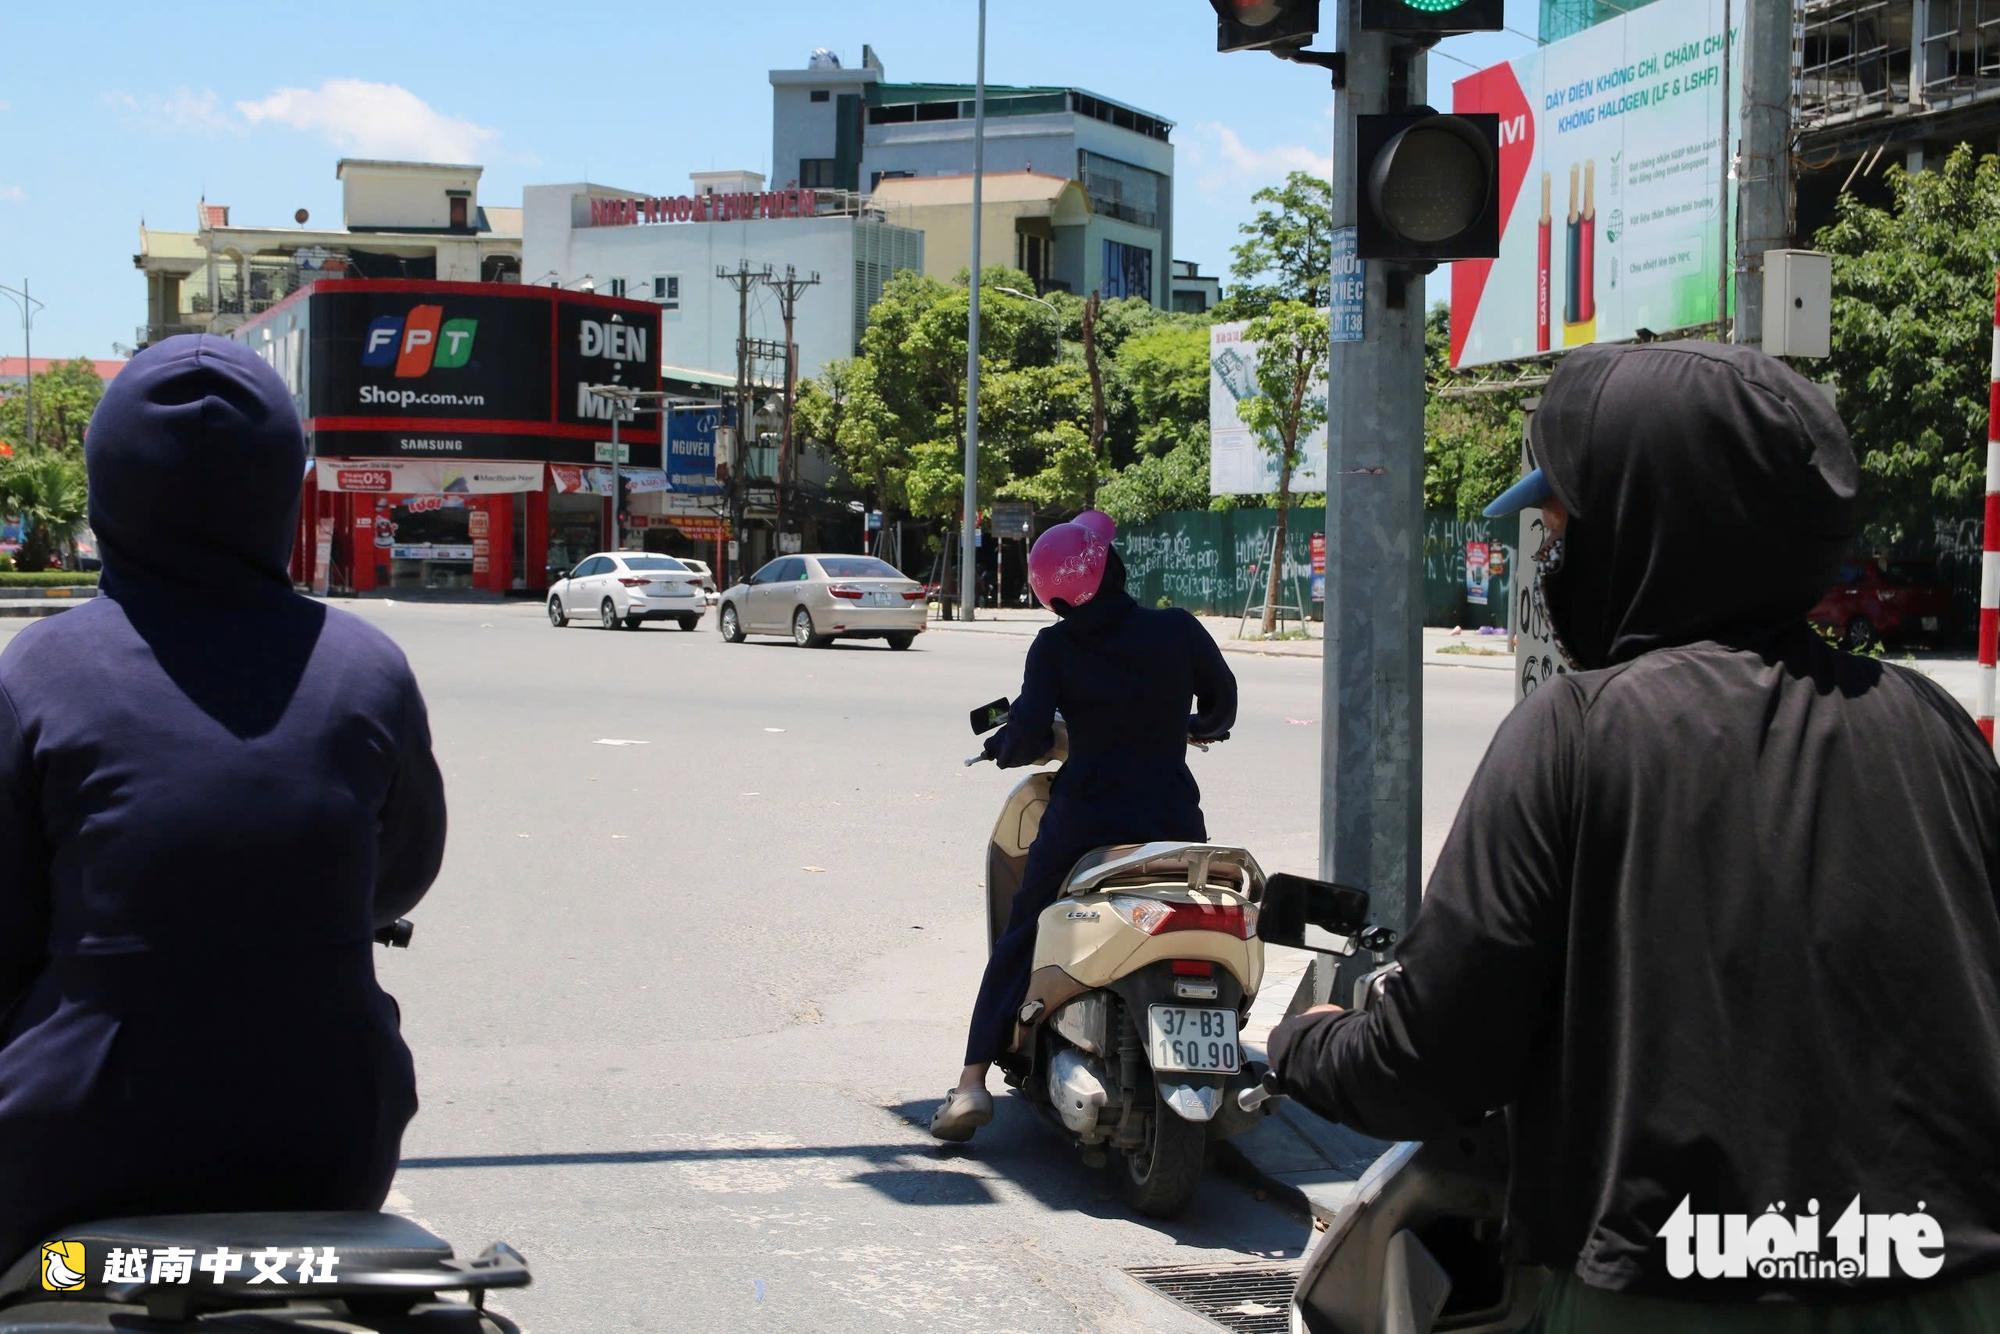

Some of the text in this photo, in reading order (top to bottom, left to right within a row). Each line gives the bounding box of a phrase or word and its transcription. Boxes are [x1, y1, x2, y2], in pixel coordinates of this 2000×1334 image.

[1545, 89, 1567, 111] DÂY
[1568, 80, 1593, 103] ĐIỆN
[1596, 65, 1635, 93] KHÔNG
[1664, 41, 1700, 70] CHẬM
[1558, 65, 1720, 135] KHÔNG HALOGEN (LF & LSHF)
[1499, 114, 1526, 148] IVI
[644, 194, 707, 223] KHOA
[368, 328, 470, 356] FPT
[579, 314, 647, 370] ĐIỆN
[359, 385, 485, 408] Shop.com.vn
[400, 439, 463, 450] SAMSUNG
[363, 472, 386, 485] 0%
[1162, 1009, 1225, 1038] 37-B3
[1159, 1039, 1235, 1069] 160.90
